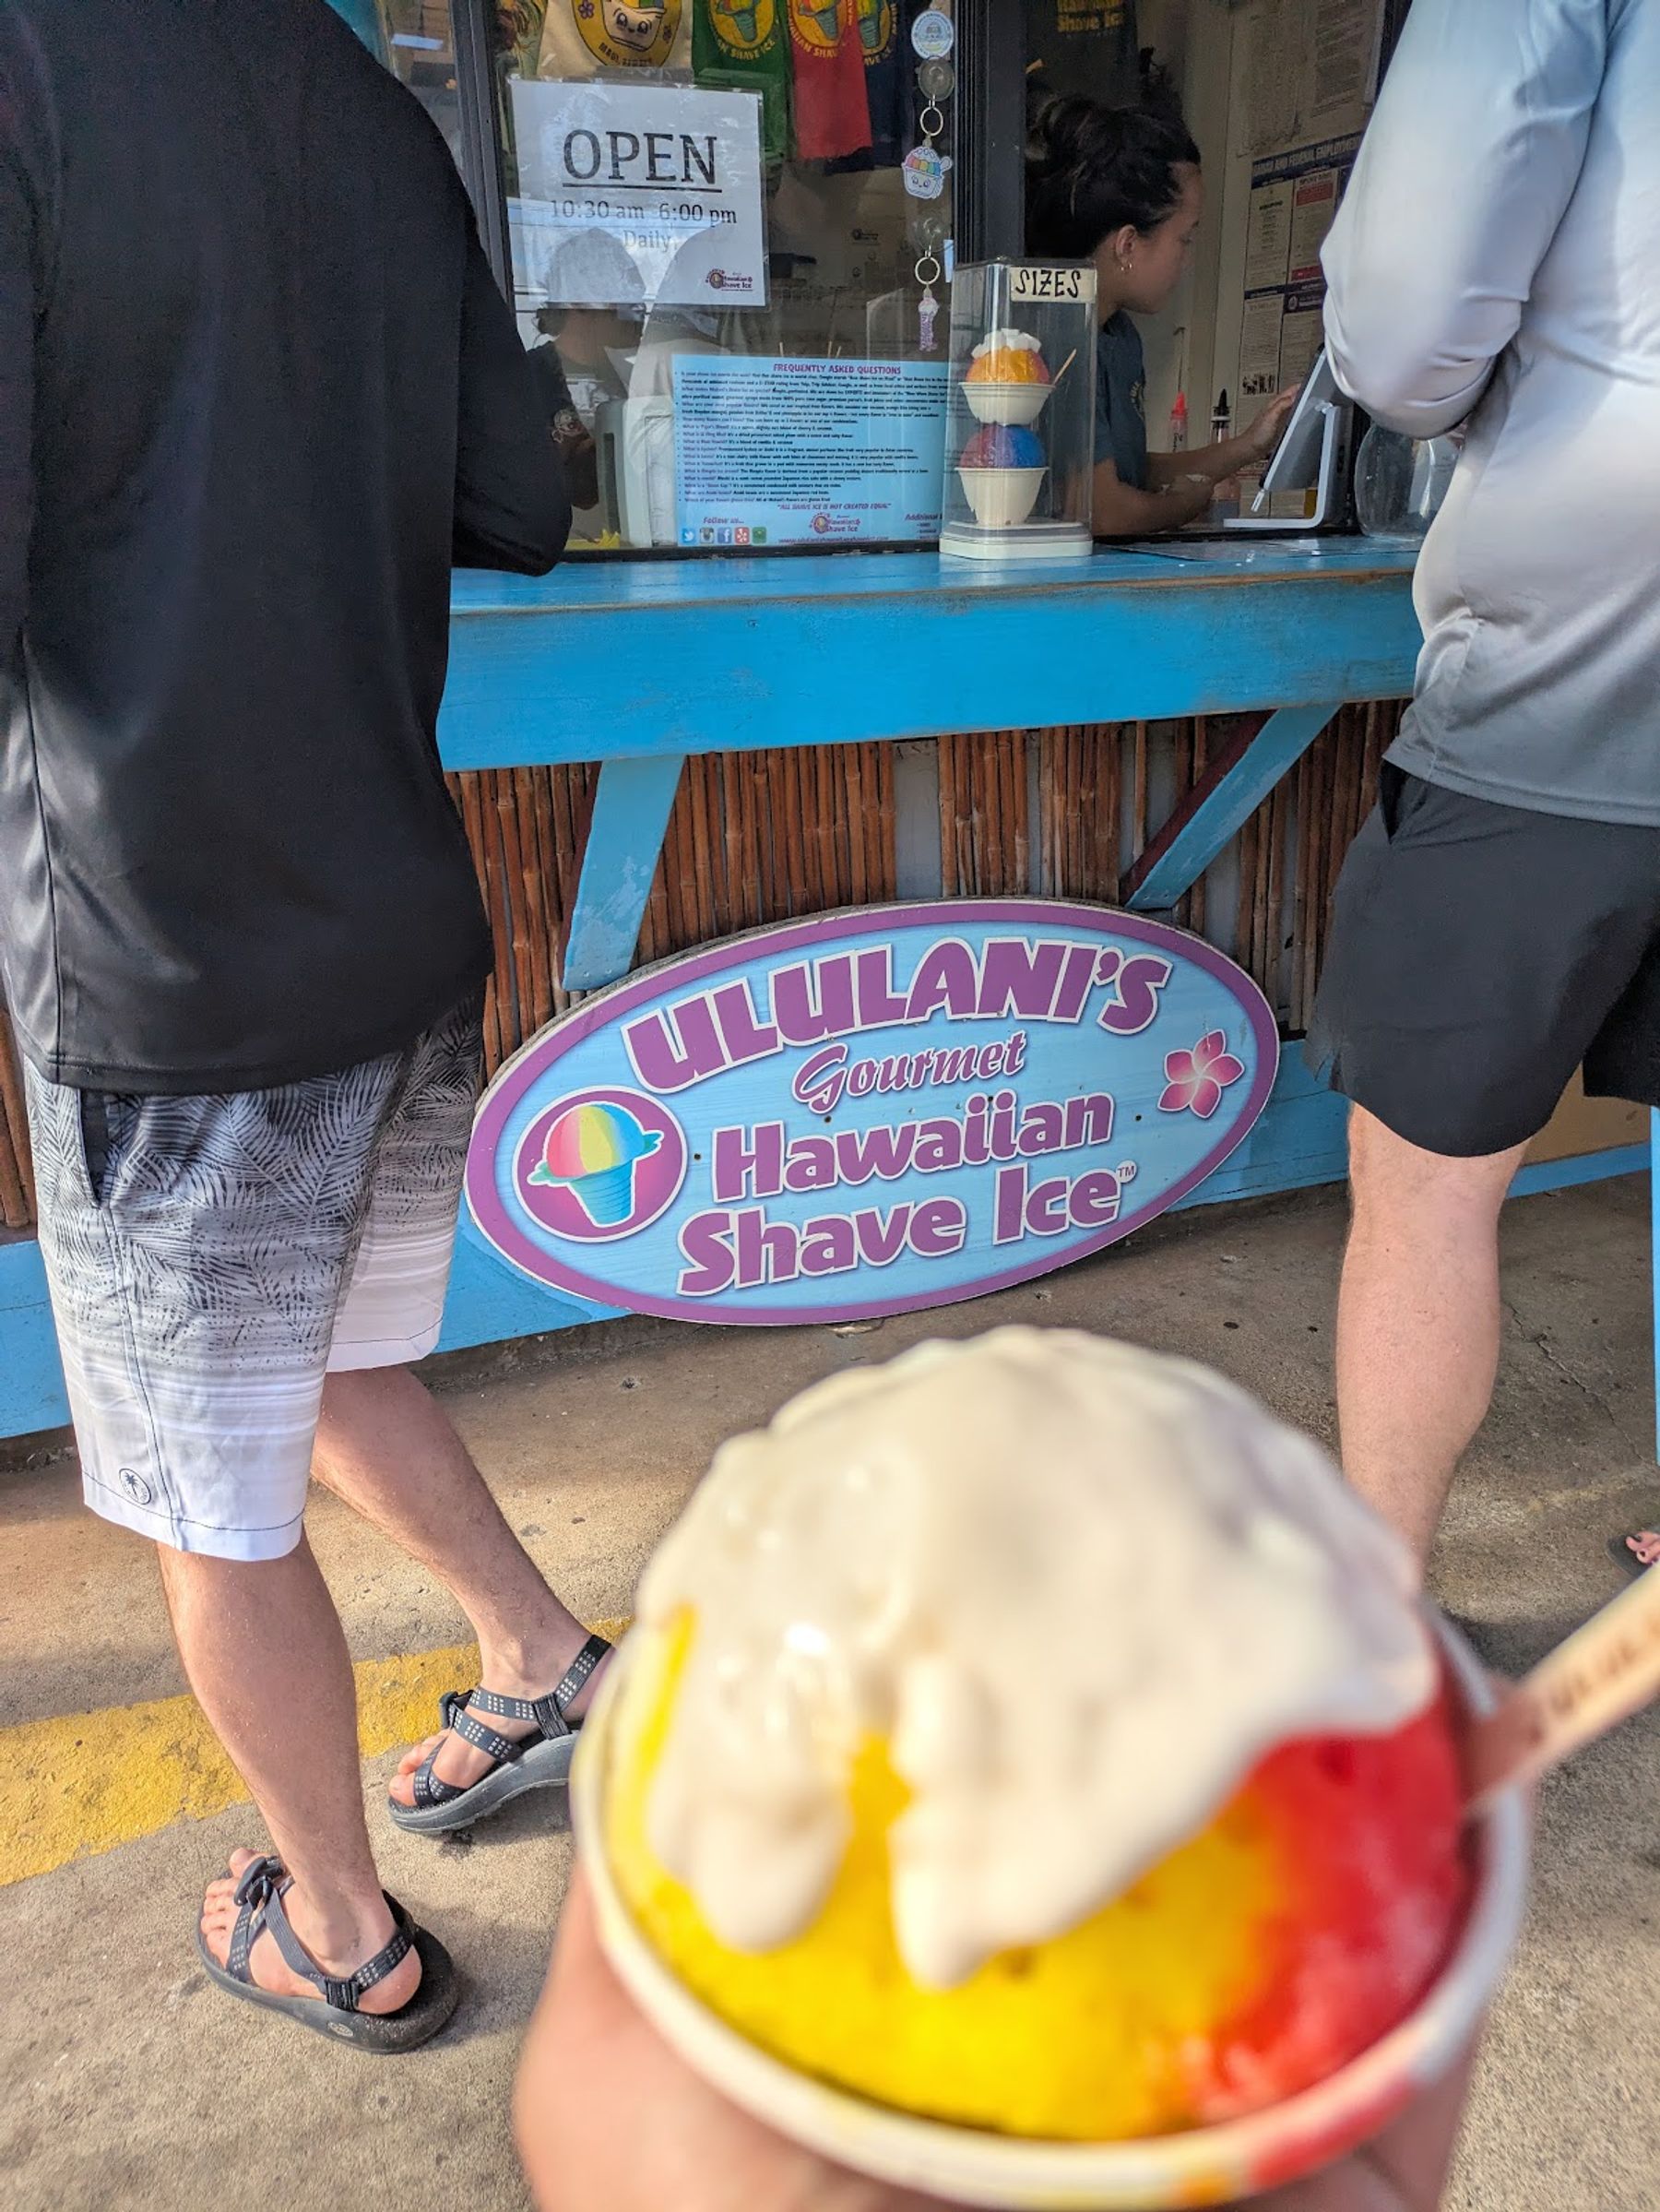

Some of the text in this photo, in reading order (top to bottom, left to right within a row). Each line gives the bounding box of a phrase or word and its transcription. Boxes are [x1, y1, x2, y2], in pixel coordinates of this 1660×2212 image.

[563, 129, 717, 184] OPEN
[551, 200, 737, 227] 10:30 am 6:00 pm
[623, 229, 671, 253] Daily
[1015, 269, 1081, 298] SIZES
[774, 363, 901, 375] FREQUENTLY ASKED QUESTIONS
[622, 937, 1171, 1093] ULULANI'S
[792, 1031, 1026, 1112] Gourmet
[712, 1092, 1115, 1202] Hawaiian
[677, 1195, 966, 1295] Shave
